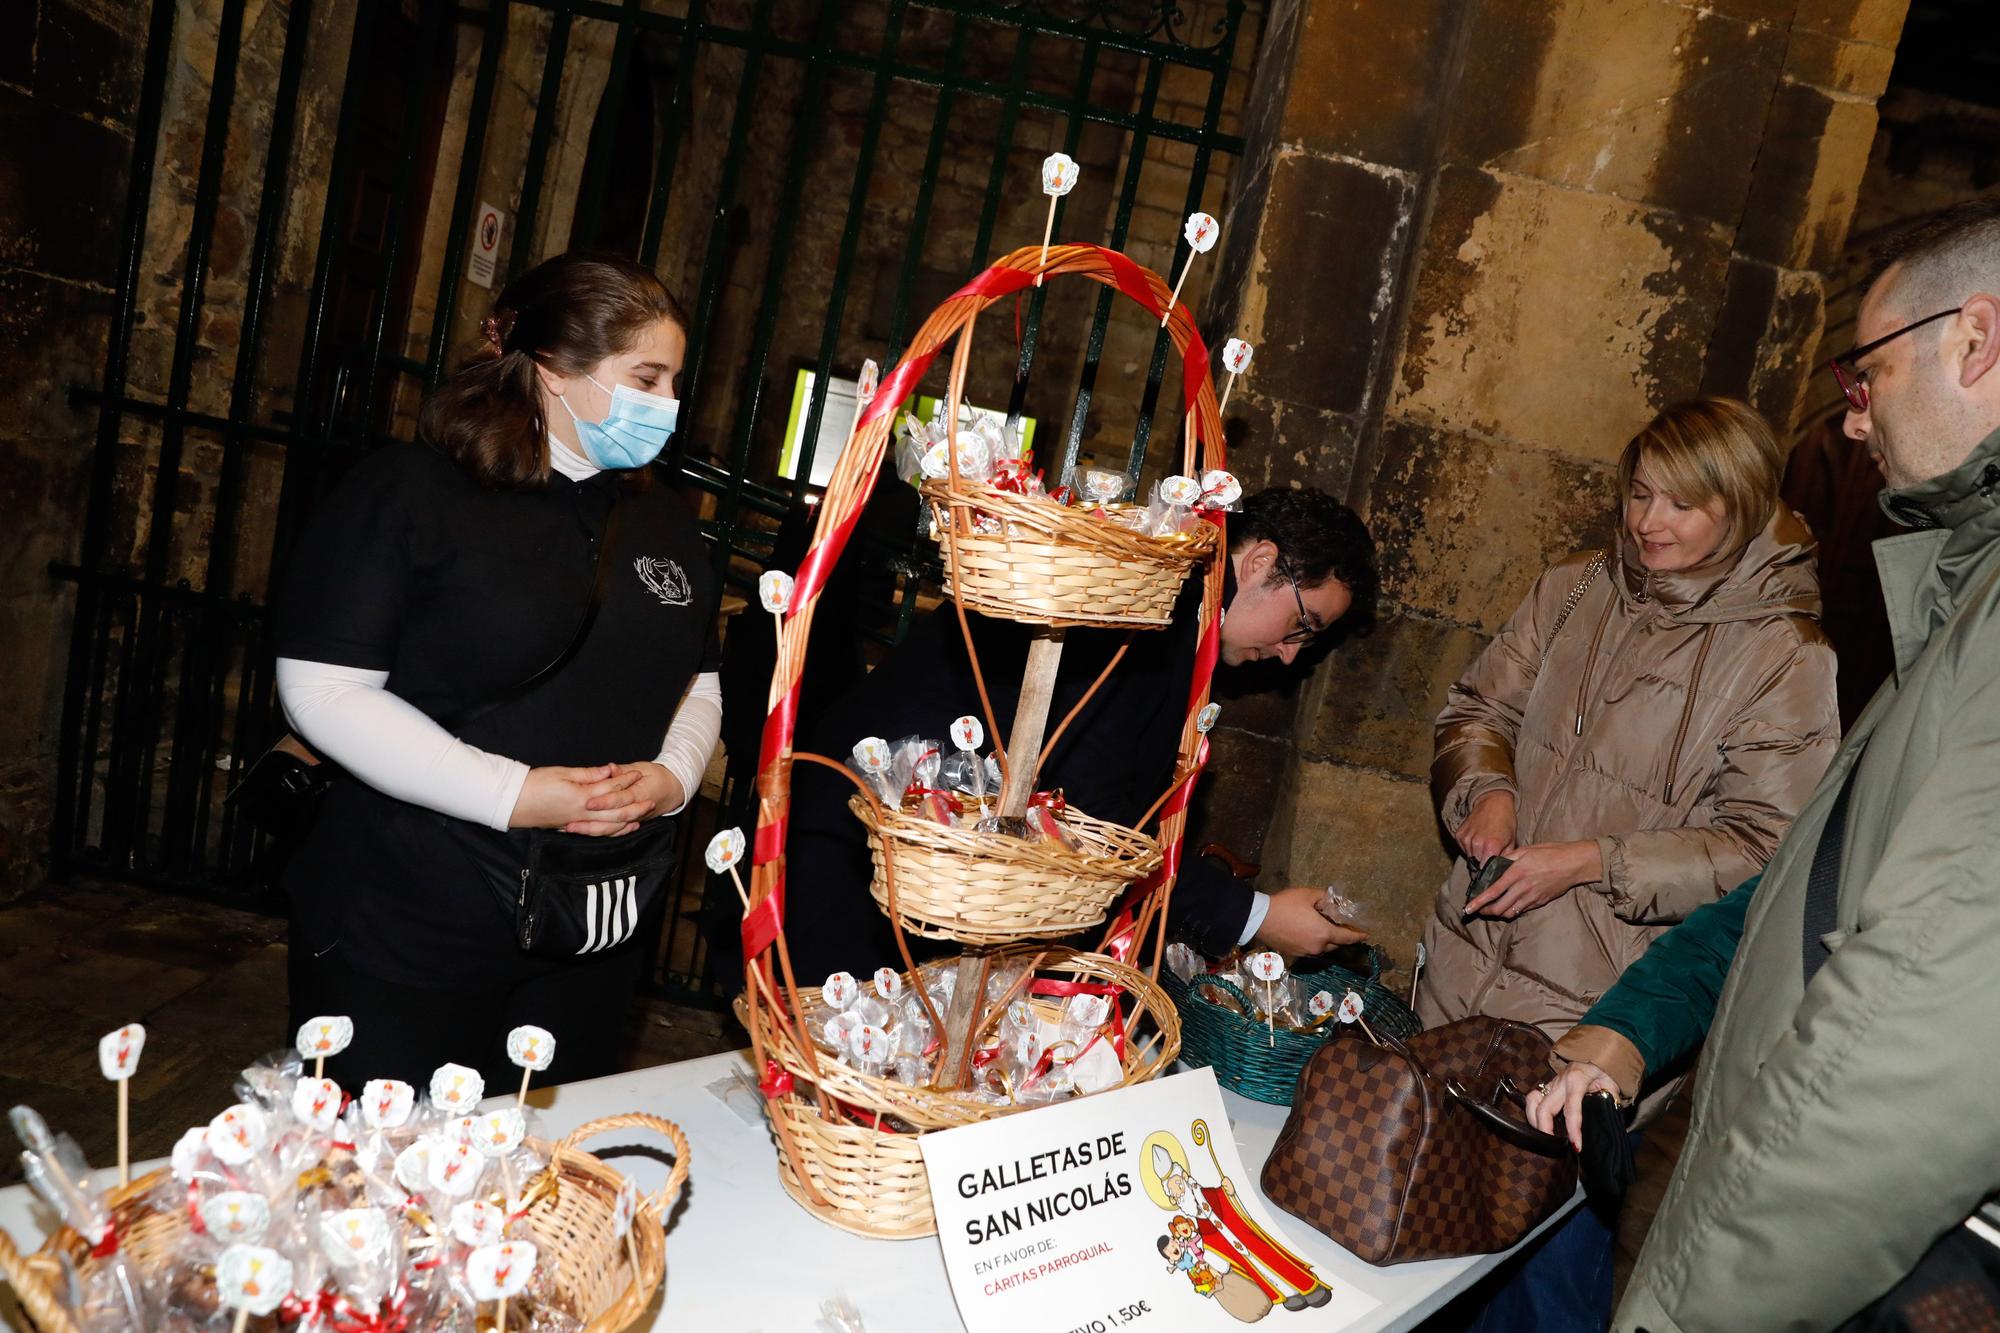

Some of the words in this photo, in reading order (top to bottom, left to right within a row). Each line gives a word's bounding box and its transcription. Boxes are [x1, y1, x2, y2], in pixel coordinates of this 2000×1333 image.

[958, 1142, 1092, 1198] GALLETAS
[1096, 1131, 1127, 1161] DE
[965, 1206, 1023, 1245] SAN
[1027, 1172, 1132, 1226] NICOLÁS
[974, 1260, 993, 1275] EN
[994, 1244, 1036, 1268] FAVOR
[1037, 1237, 1059, 1253] DE:
[983, 1267, 1039, 1297] CÁRITAS
[1038, 1241, 1114, 1277] PARROQUIAL
[1107, 1300, 1152, 1327] 1,50€
